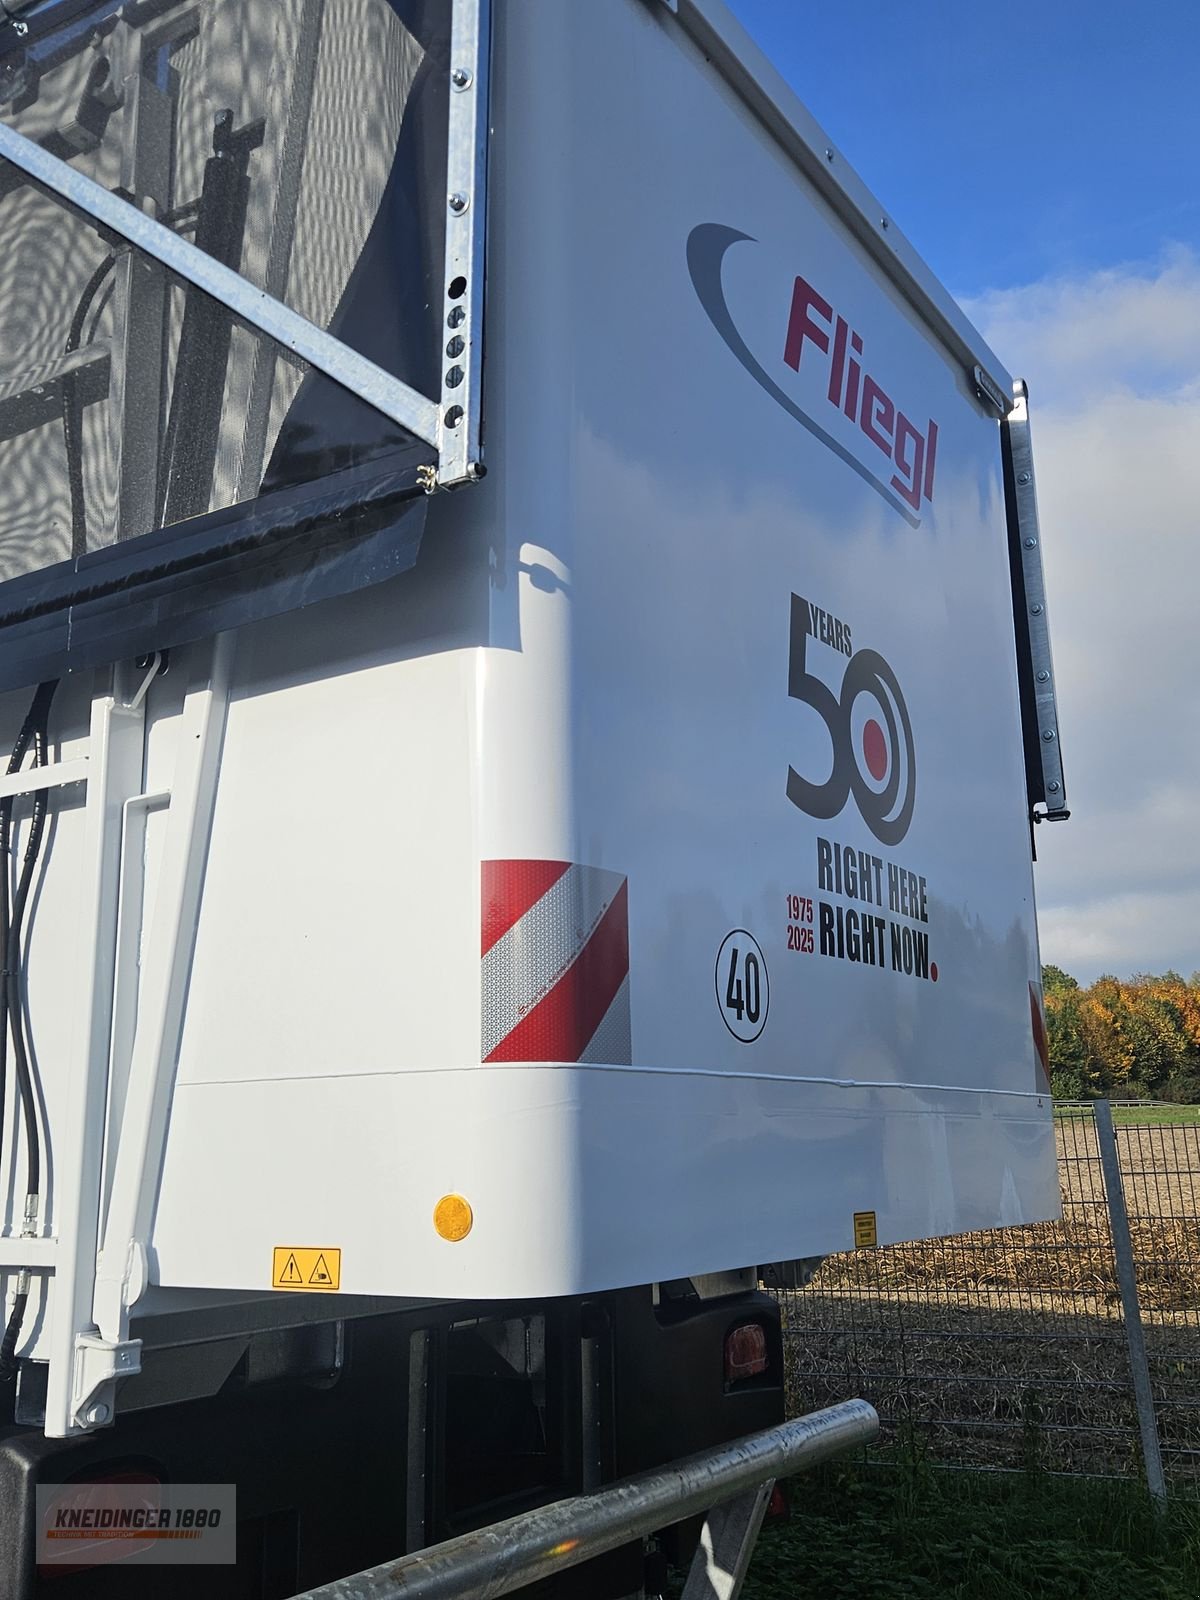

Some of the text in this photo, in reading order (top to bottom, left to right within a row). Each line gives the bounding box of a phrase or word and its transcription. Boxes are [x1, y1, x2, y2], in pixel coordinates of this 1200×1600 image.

[784, 275, 939, 511] Fliegl
[808, 602, 853, 658] YEARS
[786, 591, 916, 847] 50
[786, 894, 814, 924] 1975
[816, 836, 929, 924] RIGHT HERE
[787, 924, 815, 954] 2025
[818, 901, 939, 983] RIGHT NOW.
[726, 947, 761, 1024] 40
